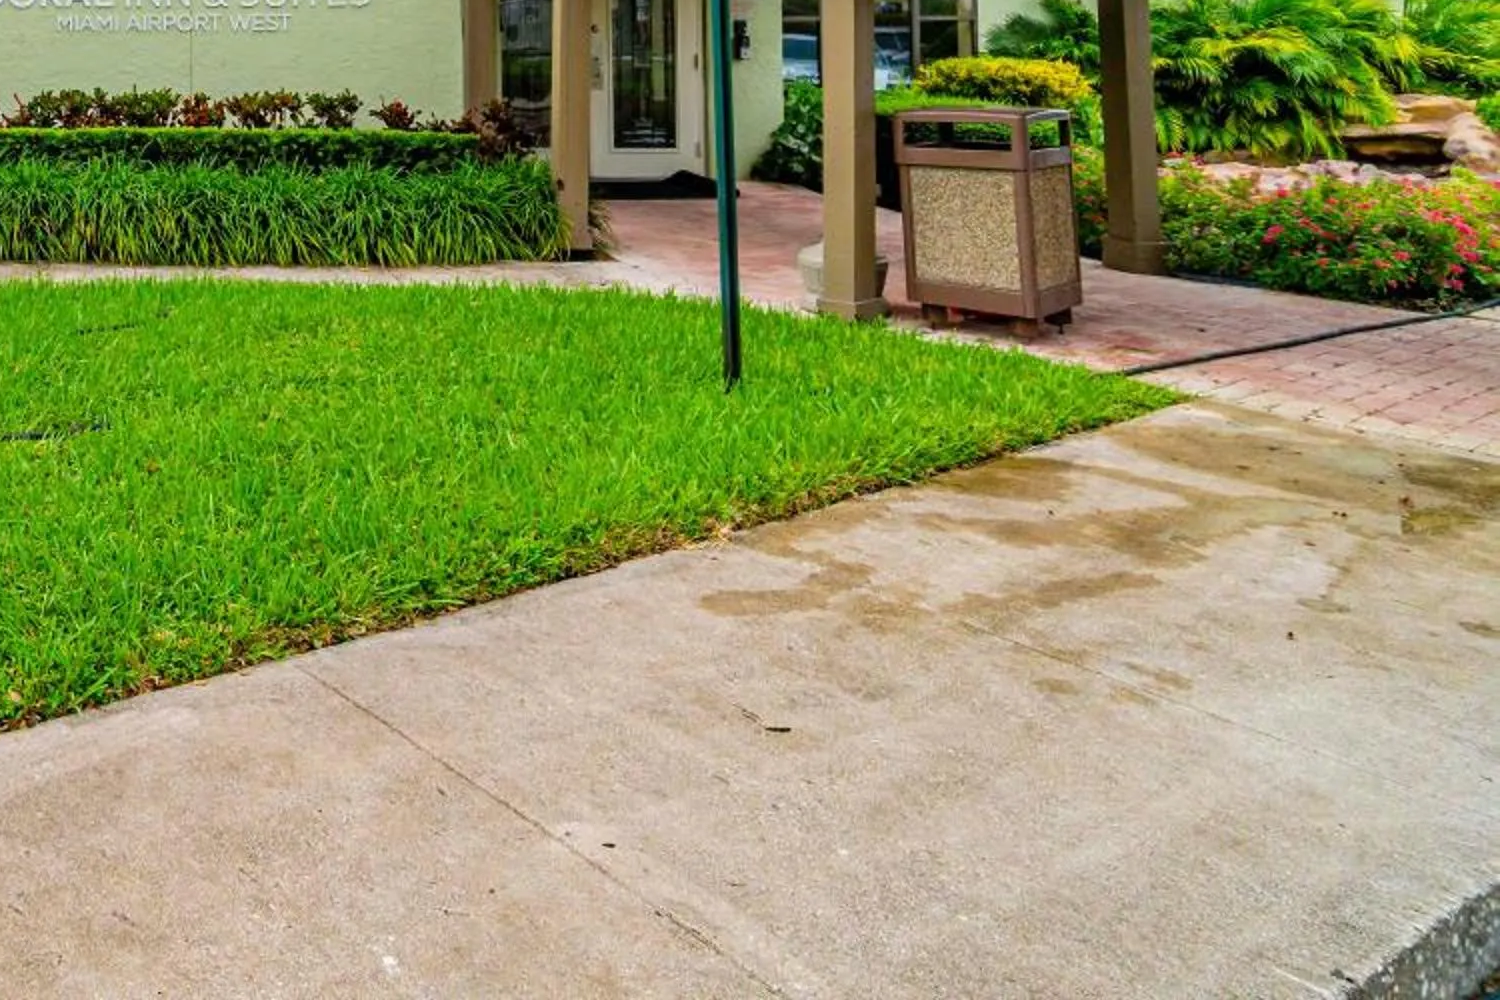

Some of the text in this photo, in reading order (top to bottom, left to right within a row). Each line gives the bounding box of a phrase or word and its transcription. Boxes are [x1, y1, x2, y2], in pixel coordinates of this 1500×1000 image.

[56, 13, 293, 33] MIAMI AIRPORT WEST
